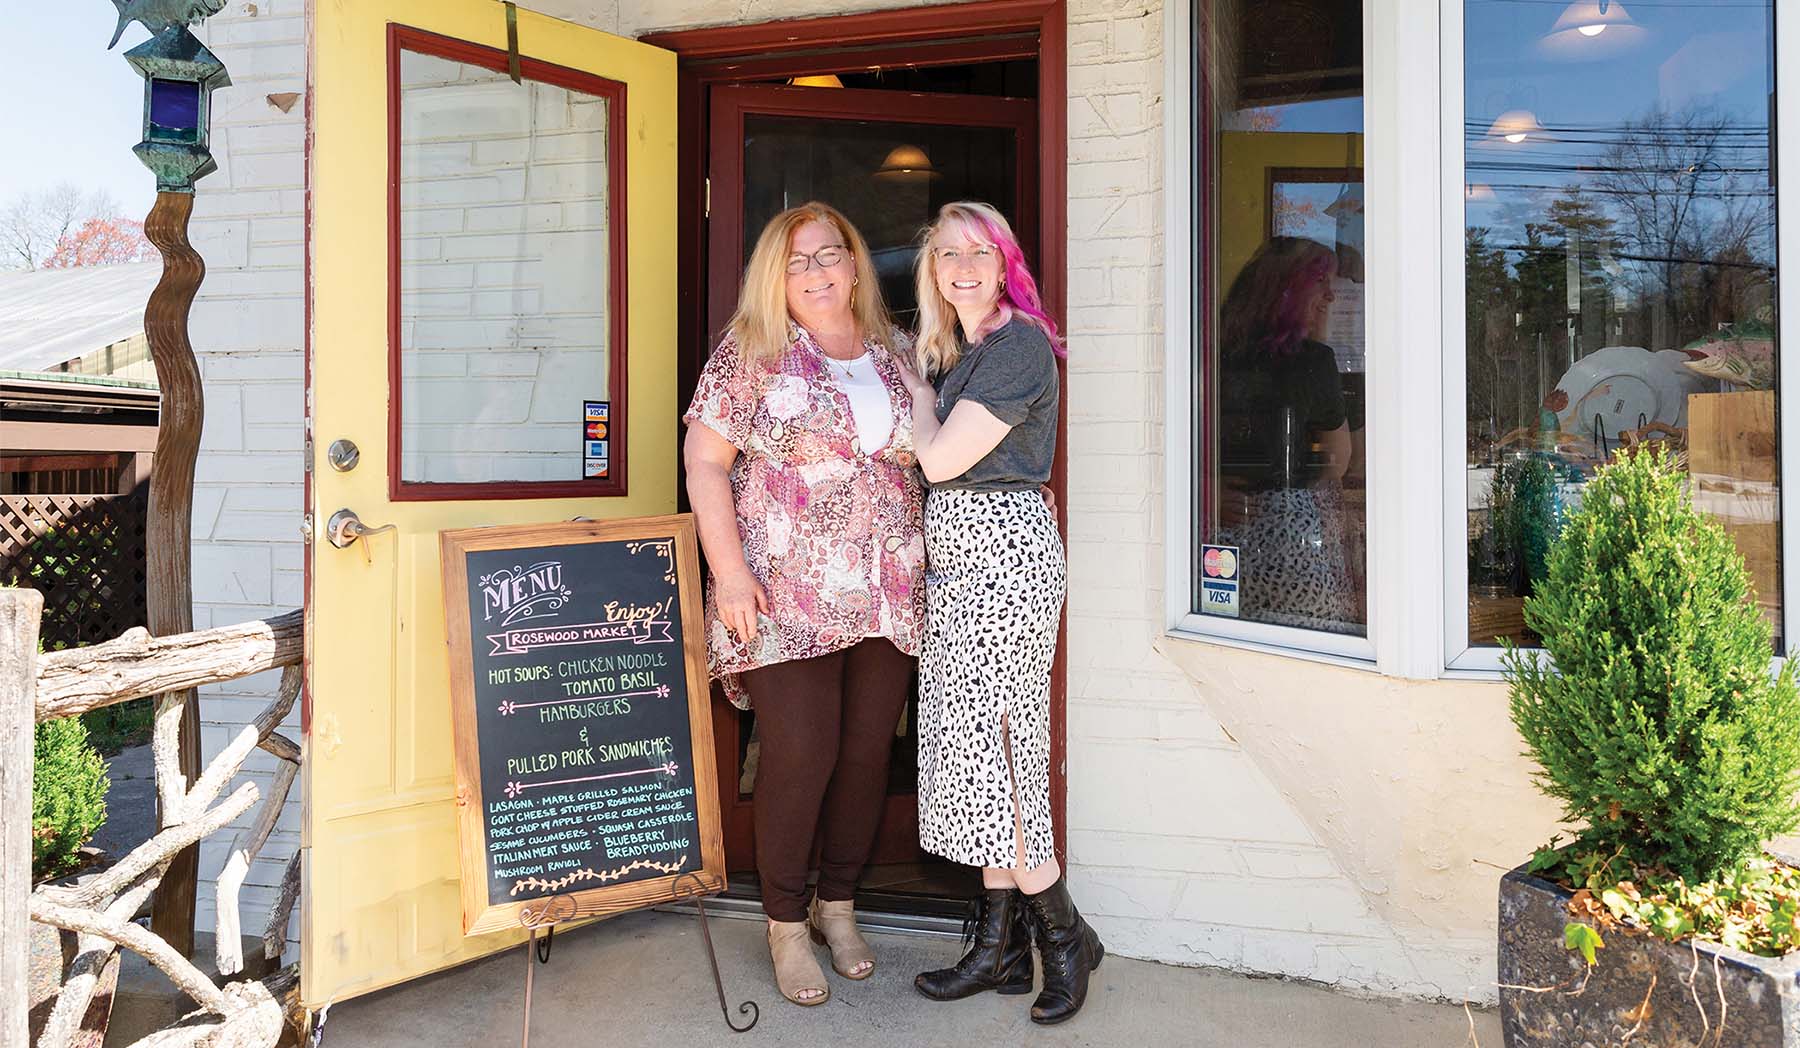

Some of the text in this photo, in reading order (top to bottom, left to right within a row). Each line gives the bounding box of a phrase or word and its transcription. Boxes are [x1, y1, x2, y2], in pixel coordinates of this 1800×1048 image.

[484, 564, 562, 621] MENU
[1209, 591, 1231, 604] VISA
[604, 596, 673, 628] Enjoy!
[511, 625, 637, 645] ROSEWOOD MARKET
[489, 653, 667, 685] HOT SOUPS: CHICKEN NOODLE
[562, 671, 659, 696] TOMATO BASIL
[540, 699, 631, 723] HAMBURGERS
[579, 727, 589, 747] &
[507, 737, 674, 775] PULLED PORK SANDWICHES
[490, 782, 662, 813] LASAGNA MAPLE GRILLED SALMON
[491, 787, 693, 826] GOAT CHEESE STUFFED ROSEMARY CHICKEN
[490, 826, 514, 838] PORK
[516, 823, 540, 834] CHOP
[552, 816, 583, 829] APPLE
[586, 812, 619, 822] CIDER
[622, 808, 653, 818] CREAM
[655, 801, 685, 812] SAUCE
[490, 813, 694, 851] SESAME CUCUMBERS SQUASH CASSEROLE
[561, 840, 592, 854] SAUCE
[604, 830, 665, 847] BLUEBERRY
[495, 859, 581, 879] MUSHROOM RAVIOLI
